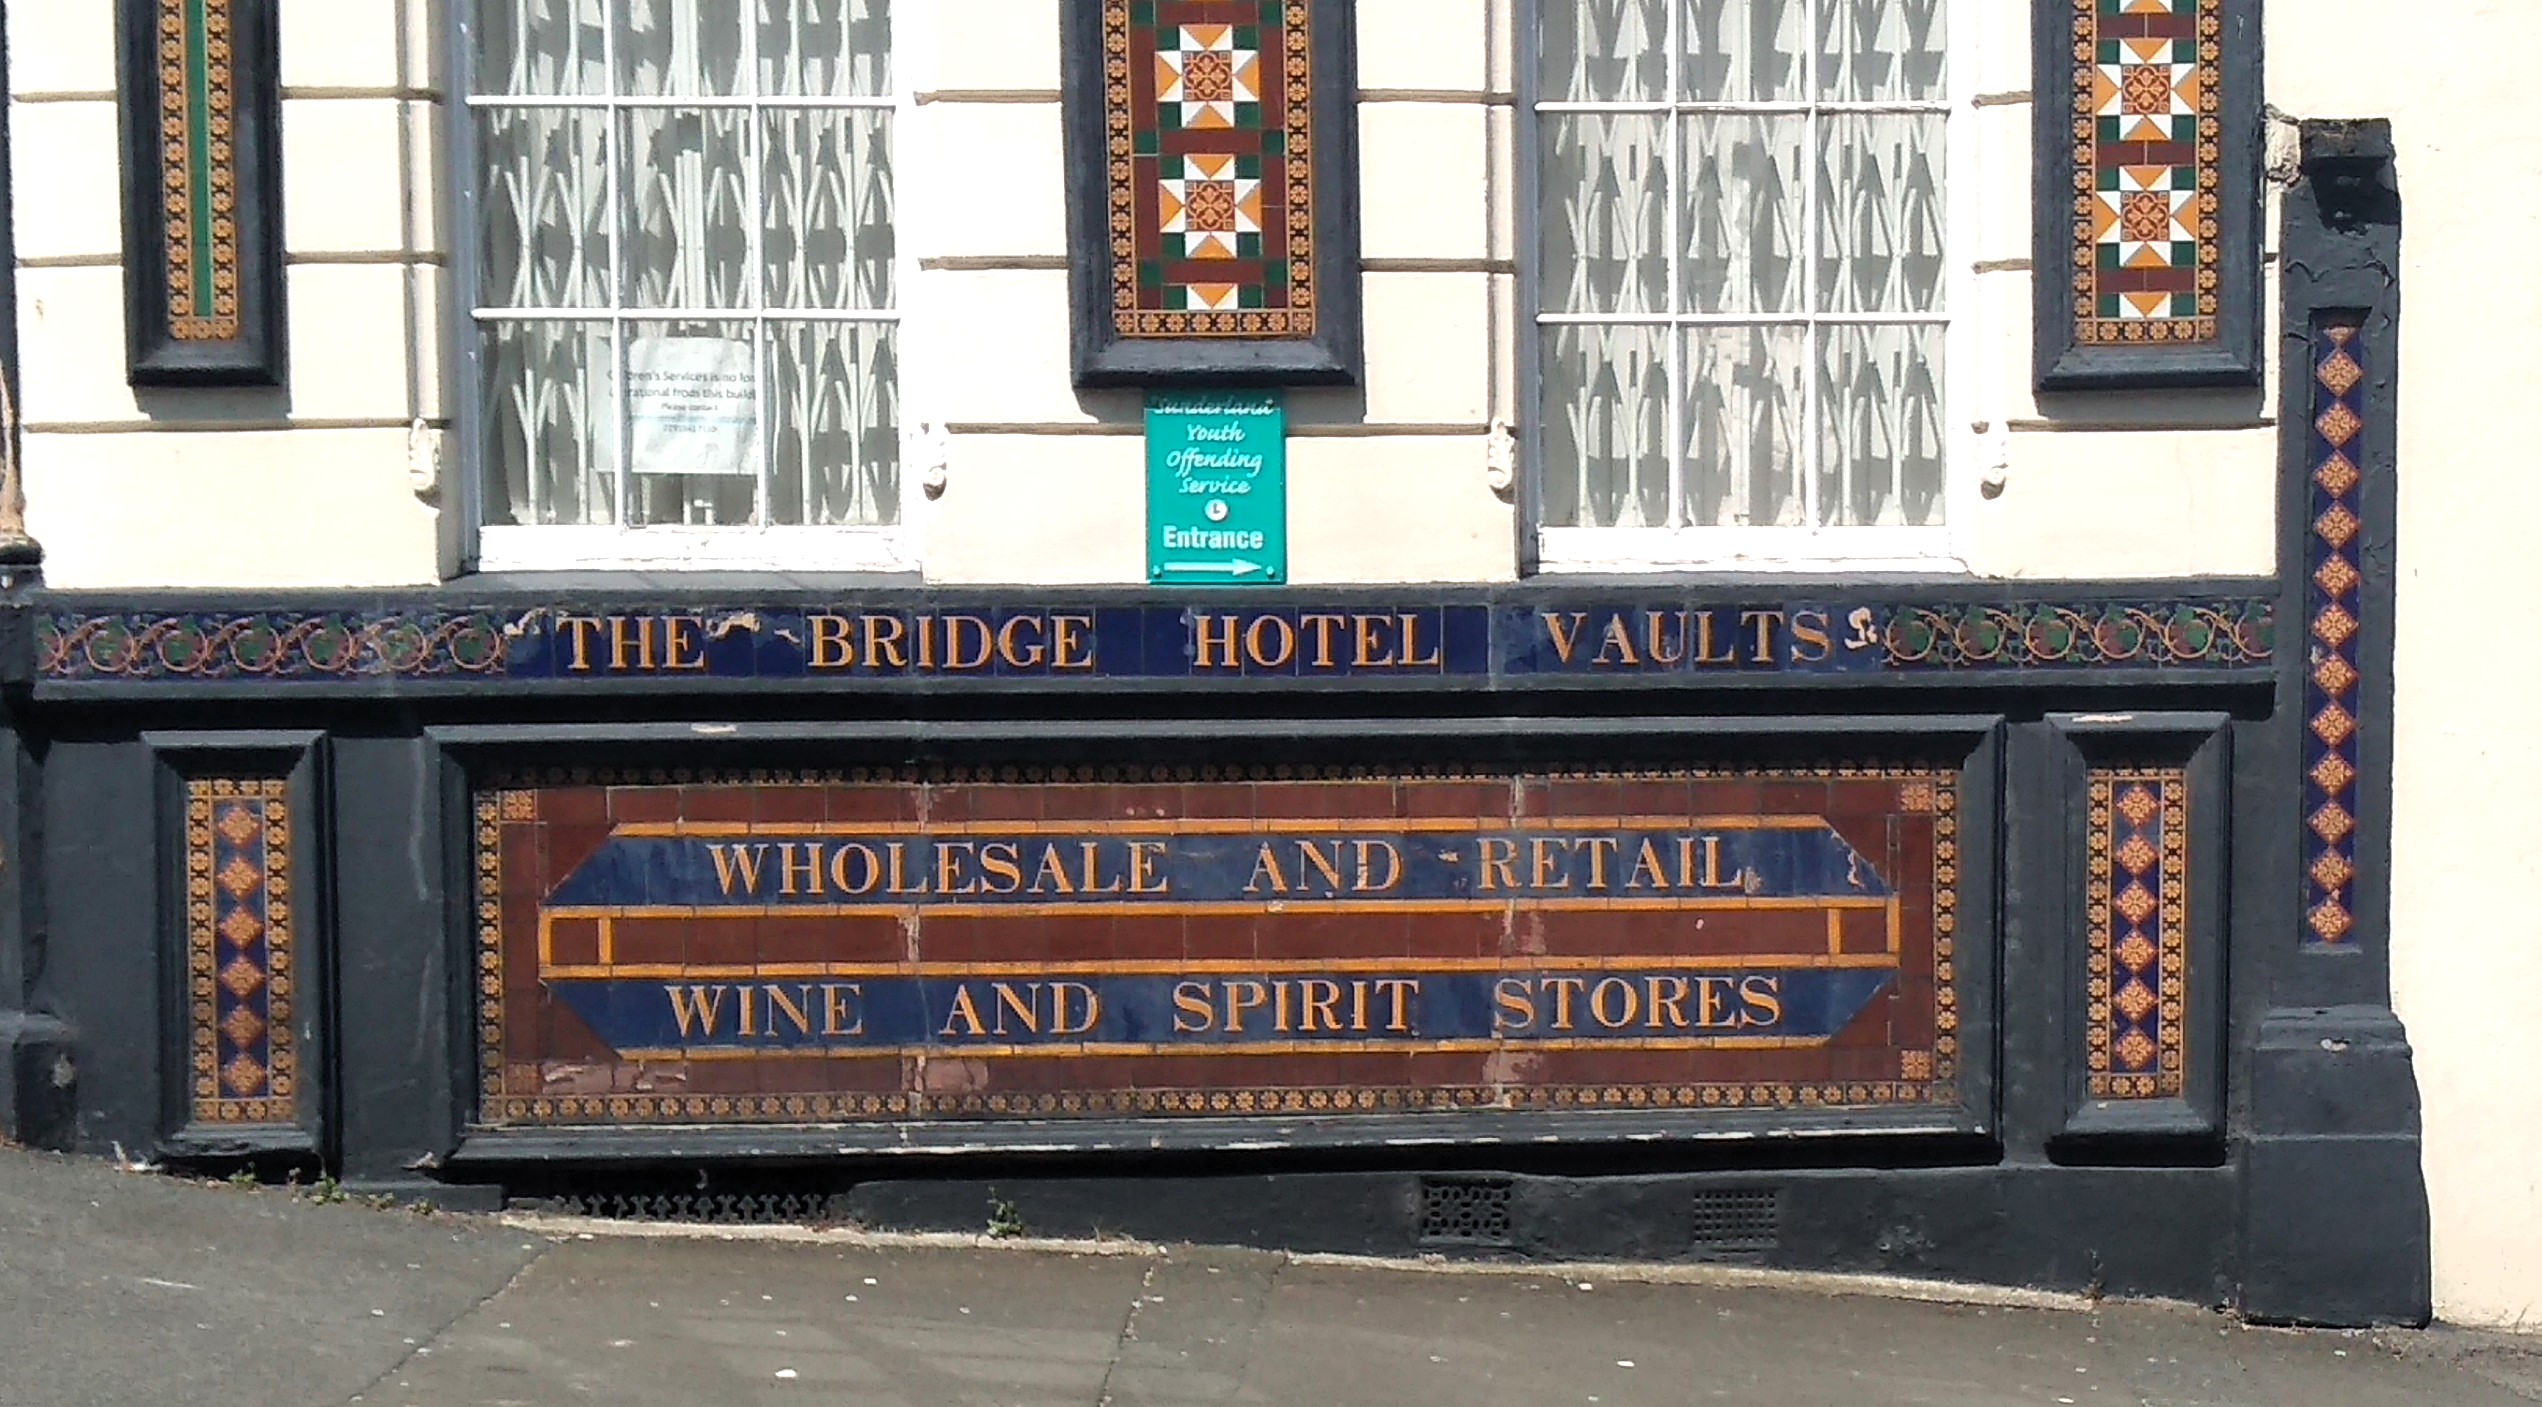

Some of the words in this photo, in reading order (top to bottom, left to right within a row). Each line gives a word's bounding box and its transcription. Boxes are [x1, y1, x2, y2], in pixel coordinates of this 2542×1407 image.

[663, 370, 708, 382] Services
[702, 388, 723, 399] this
[1186, 420, 1246, 441] Youth
[1165, 446, 1264, 478] Offending
[1177, 475, 1252, 494] Service
[1162, 524, 1265, 550] Entrance
[556, 613, 705, 670] THE
[806, 612, 1096, 668] BRIDGE
[1191, 613, 1441, 667] HOTEL
[1540, 610, 1836, 666] VAULTS
[705, 840, 1169, 897] WHOLESALE
[1242, 837, 1403, 894] AND
[1475, 835, 1746, 892] RETAIL
[664, 982, 864, 1039] WINE
[938, 981, 1102, 1038] AND
[1171, 977, 1422, 1033] SPIRIT
[1491, 974, 1783, 1030] STORES
